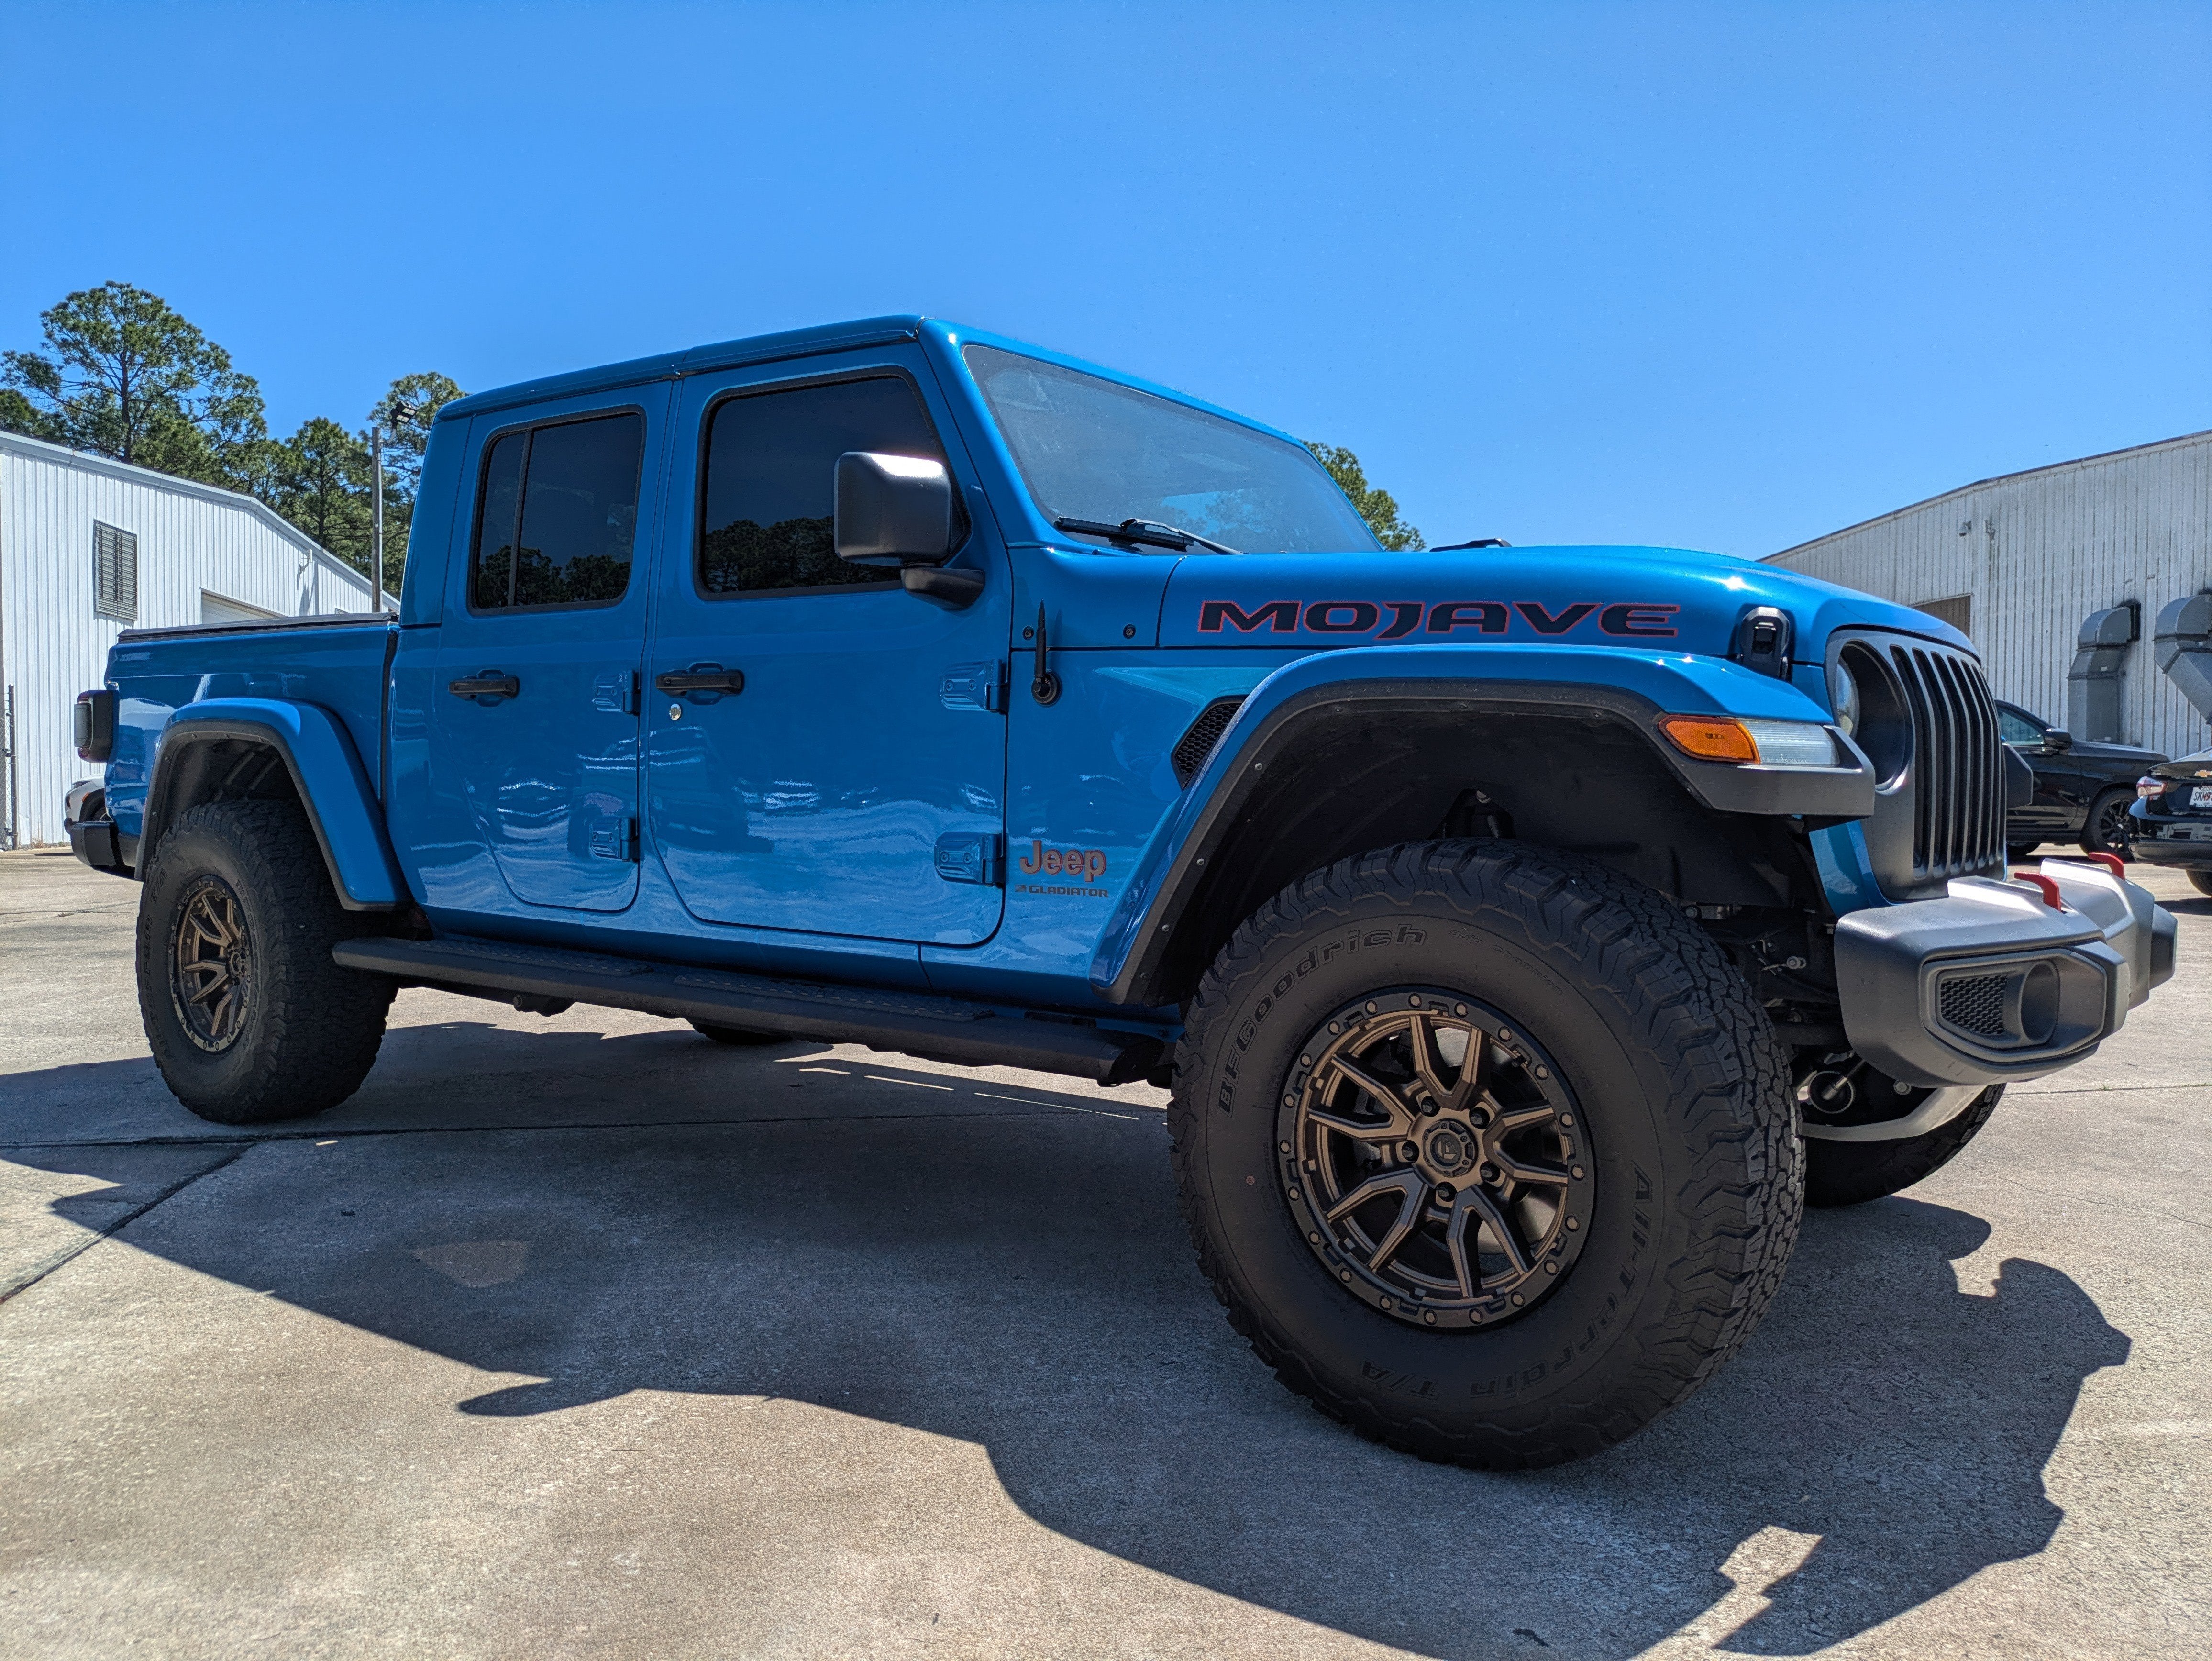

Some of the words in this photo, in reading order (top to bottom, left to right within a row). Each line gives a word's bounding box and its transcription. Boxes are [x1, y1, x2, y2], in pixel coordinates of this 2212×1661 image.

[1197, 600, 1681, 641] MOJAVE
[1019, 840, 1107, 883] Jeep
[1028, 885, 1109, 898] GLADIATOR
[1449, 929, 1484, 945] Baja
[1218, 924, 1427, 1118] BFGoodrich
[1469, 1160, 1652, 1400] All-Terrain
[1360, 1357, 1440, 1400] T/A
